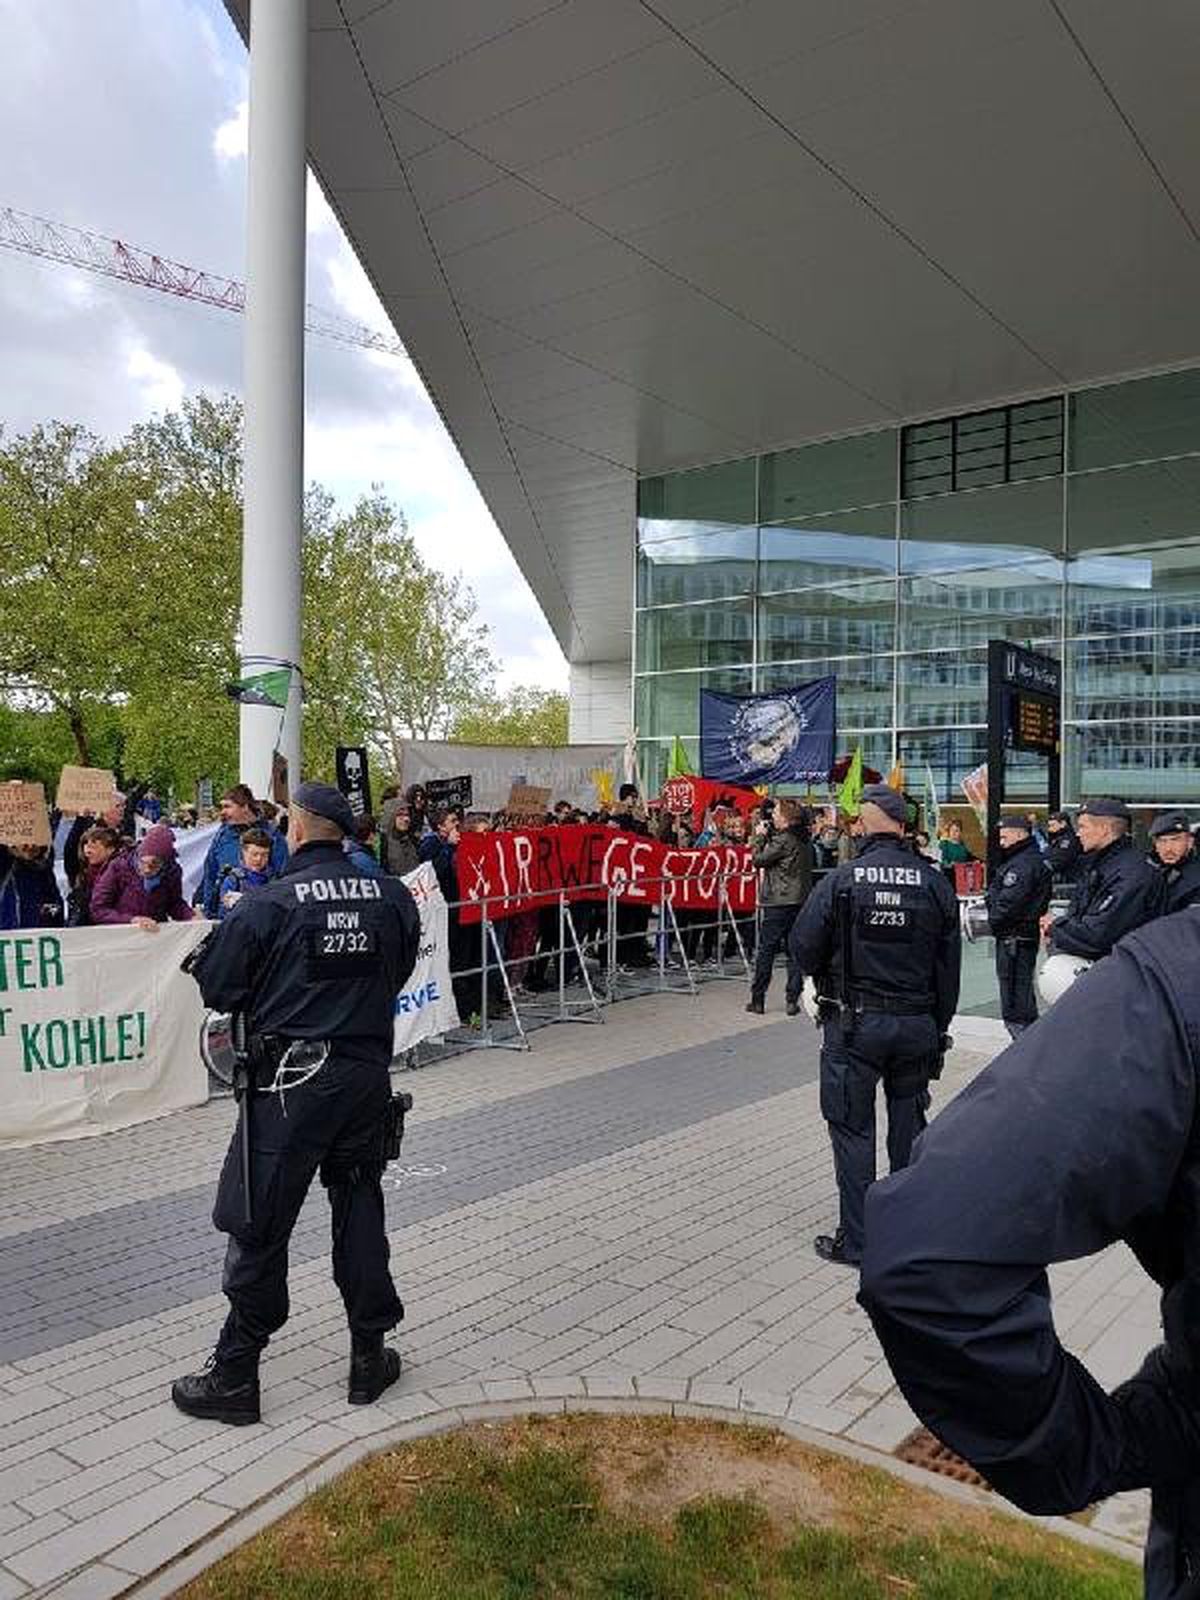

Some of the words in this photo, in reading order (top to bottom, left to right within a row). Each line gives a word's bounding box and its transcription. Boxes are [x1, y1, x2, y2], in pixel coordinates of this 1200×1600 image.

[853, 866, 922, 885] POLIZEI
[294, 879, 383, 902] POLIZEI
[875, 891, 901, 906] NRW
[327, 911, 360, 930] NRW
[869, 910, 905, 927] 2733
[323, 932, 369, 953] 2732
[395, 981, 440, 1014] RVE
[21, 1011, 146, 1073] KOHLE!
